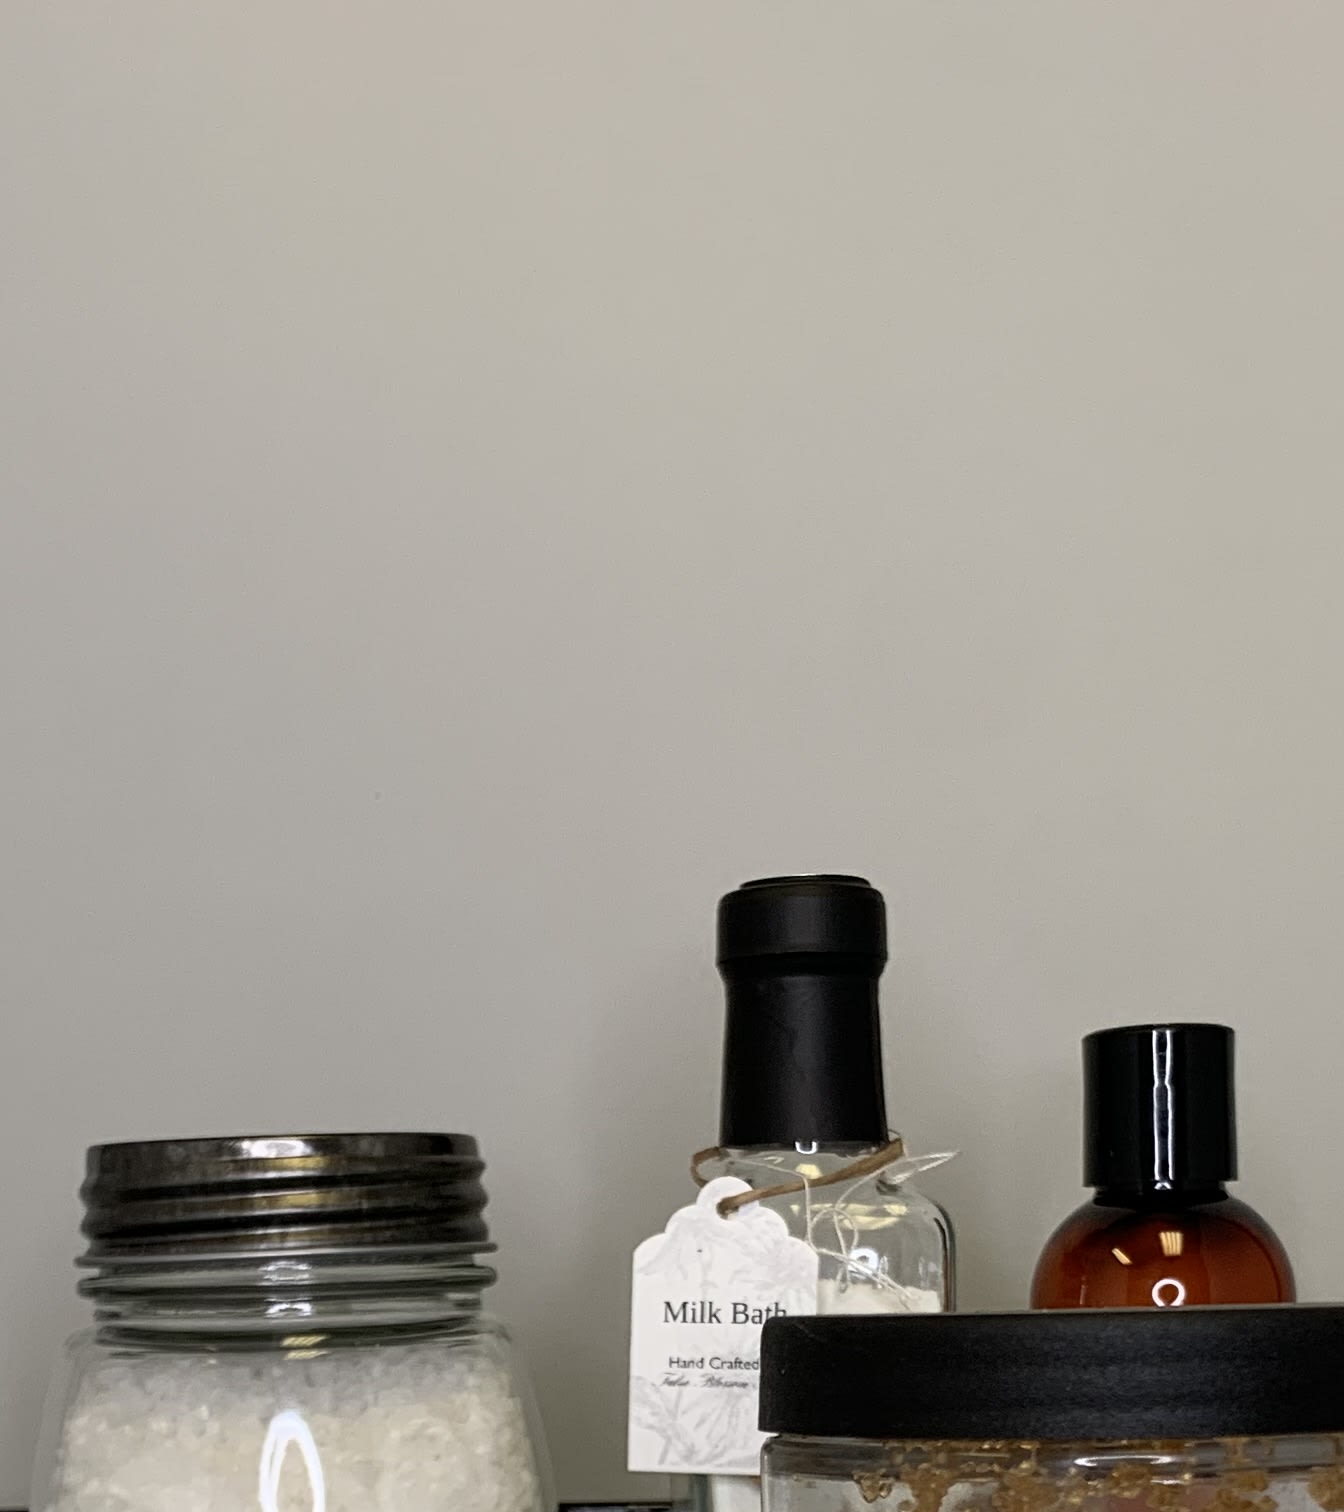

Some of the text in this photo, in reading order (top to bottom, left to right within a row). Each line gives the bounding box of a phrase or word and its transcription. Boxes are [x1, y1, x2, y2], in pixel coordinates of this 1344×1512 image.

[663, 1301, 787, 1325] Milk Bath
[668, 1356, 760, 1371] Hand Crafted
